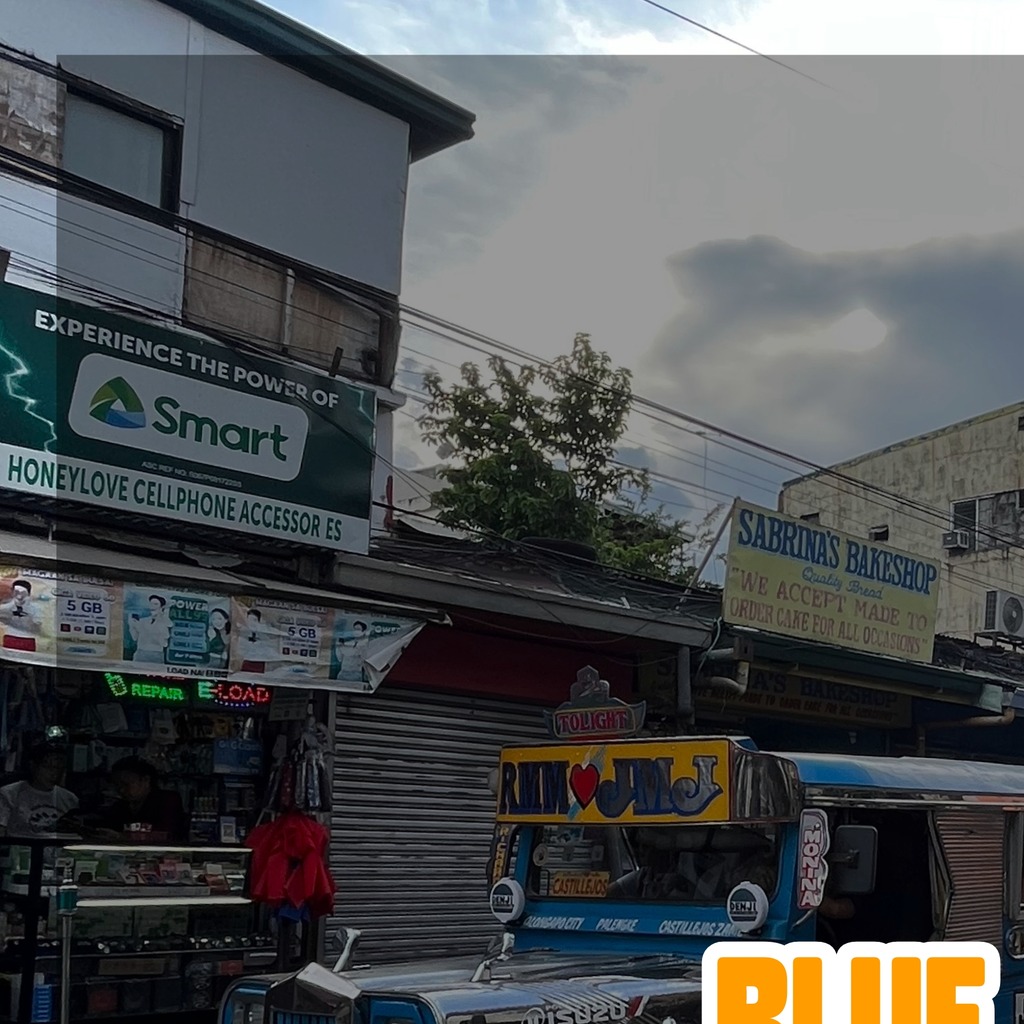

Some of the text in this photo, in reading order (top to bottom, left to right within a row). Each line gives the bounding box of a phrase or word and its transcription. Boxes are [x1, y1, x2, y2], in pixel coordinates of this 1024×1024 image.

[35, 309, 340, 409] EXPERIENCE THE POWER OF
[152, 396, 289, 462] Smart
[8, 454, 129, 500] HONEYLOVE
[133, 479, 236, 521] CELLPHONE
[738, 508, 938, 595] SABRINA'S BAKESHOP
[802, 566, 885, 600] Quality Bread
[67, 600, 103, 614] 5 GB
[170, 599, 208, 611] POWER
[777, 580, 847, 613] ACCEPT
[854, 599, 900, 627] MADE
[907, 612, 928, 632] TO
[729, 597, 773, 624] ORDER
[776, 607, 809, 633] CAKE
[812, 614, 835, 636] FOR
[838, 620, 860, 642] ALL
[288, 626, 317, 639] 5 GB
[166, 666, 189, 676] LOAD
[131, 683, 185, 701] REPAIR
[559, 711, 627, 732] TOLIGHT
[800, 829, 822, 907] MONINA
[553, 878, 608, 895] CASTILLEJOS
[565, 917, 585, 930] CITY
[659, 920, 717, 936] CASTILLEJOS
